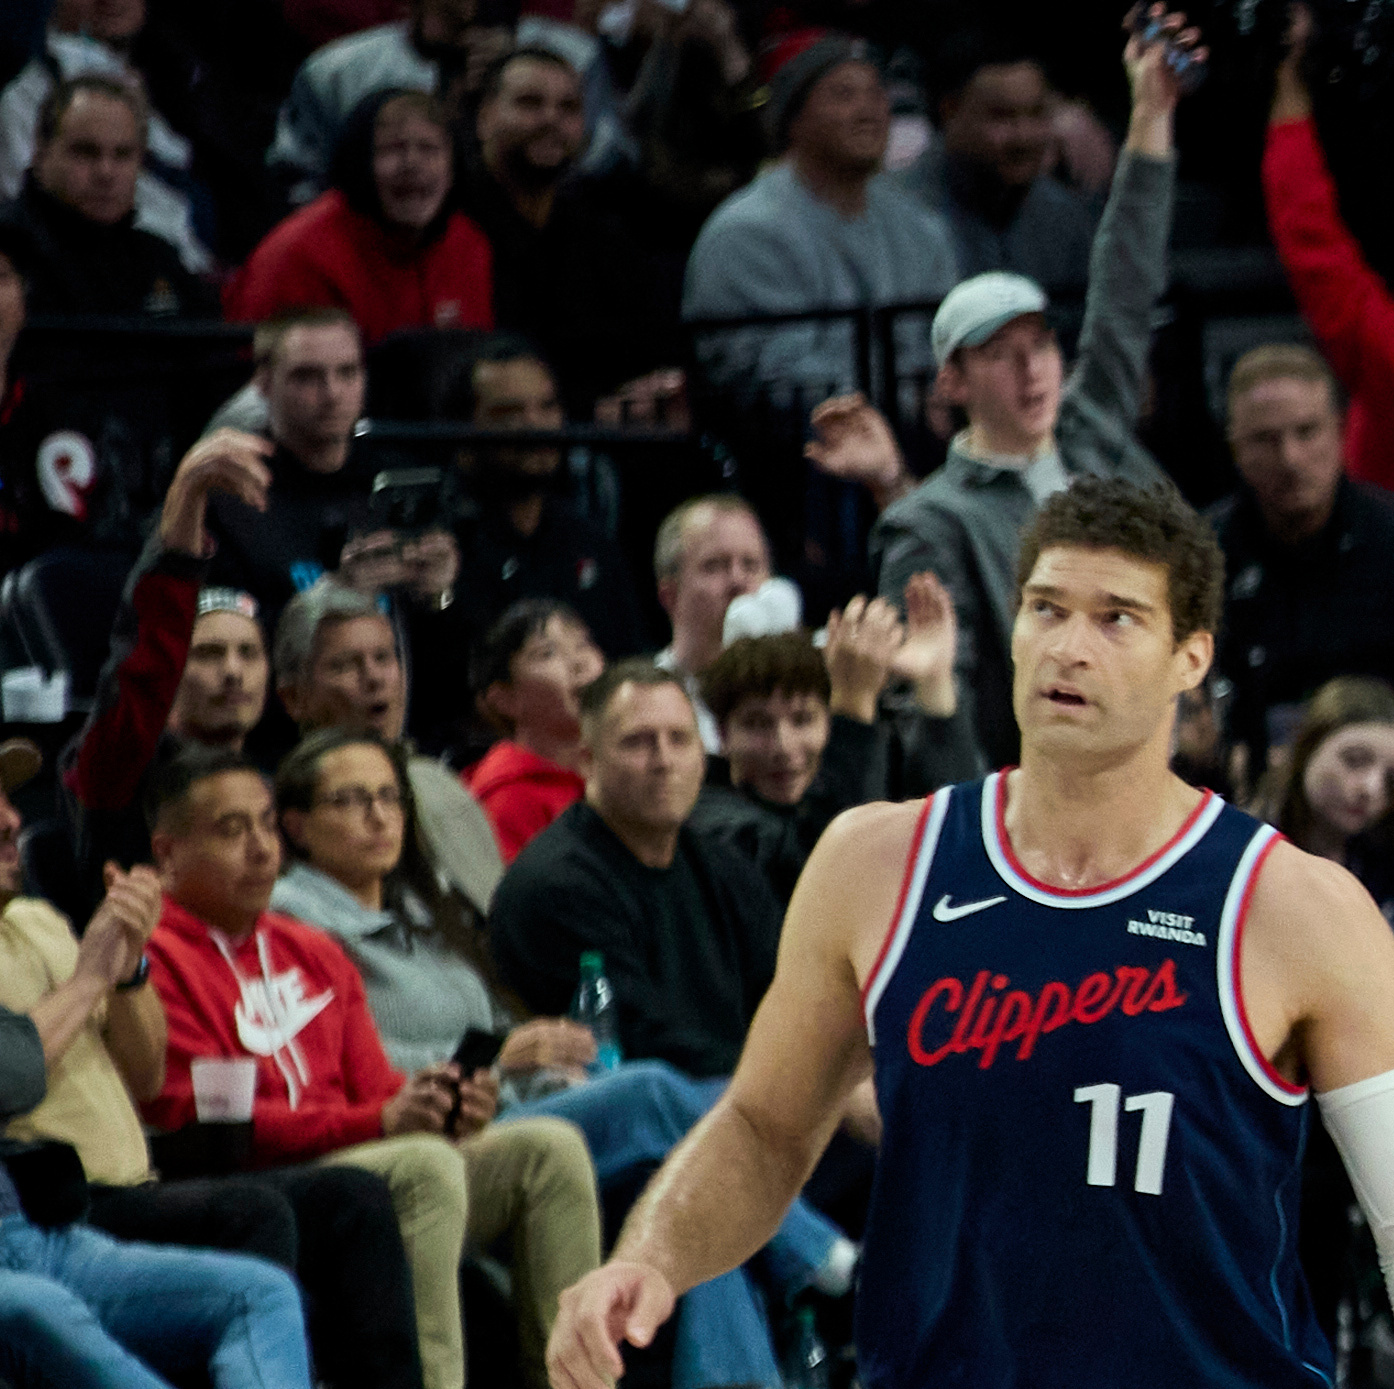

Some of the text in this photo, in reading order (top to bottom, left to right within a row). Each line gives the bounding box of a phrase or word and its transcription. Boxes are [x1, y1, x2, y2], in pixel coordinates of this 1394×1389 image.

[1126, 920, 1207, 947] RWANDA
[1147, 909, 1195, 930] VISIT
[907, 958, 1188, 1070] Clippers
[1073, 1082, 1175, 1196] 11
